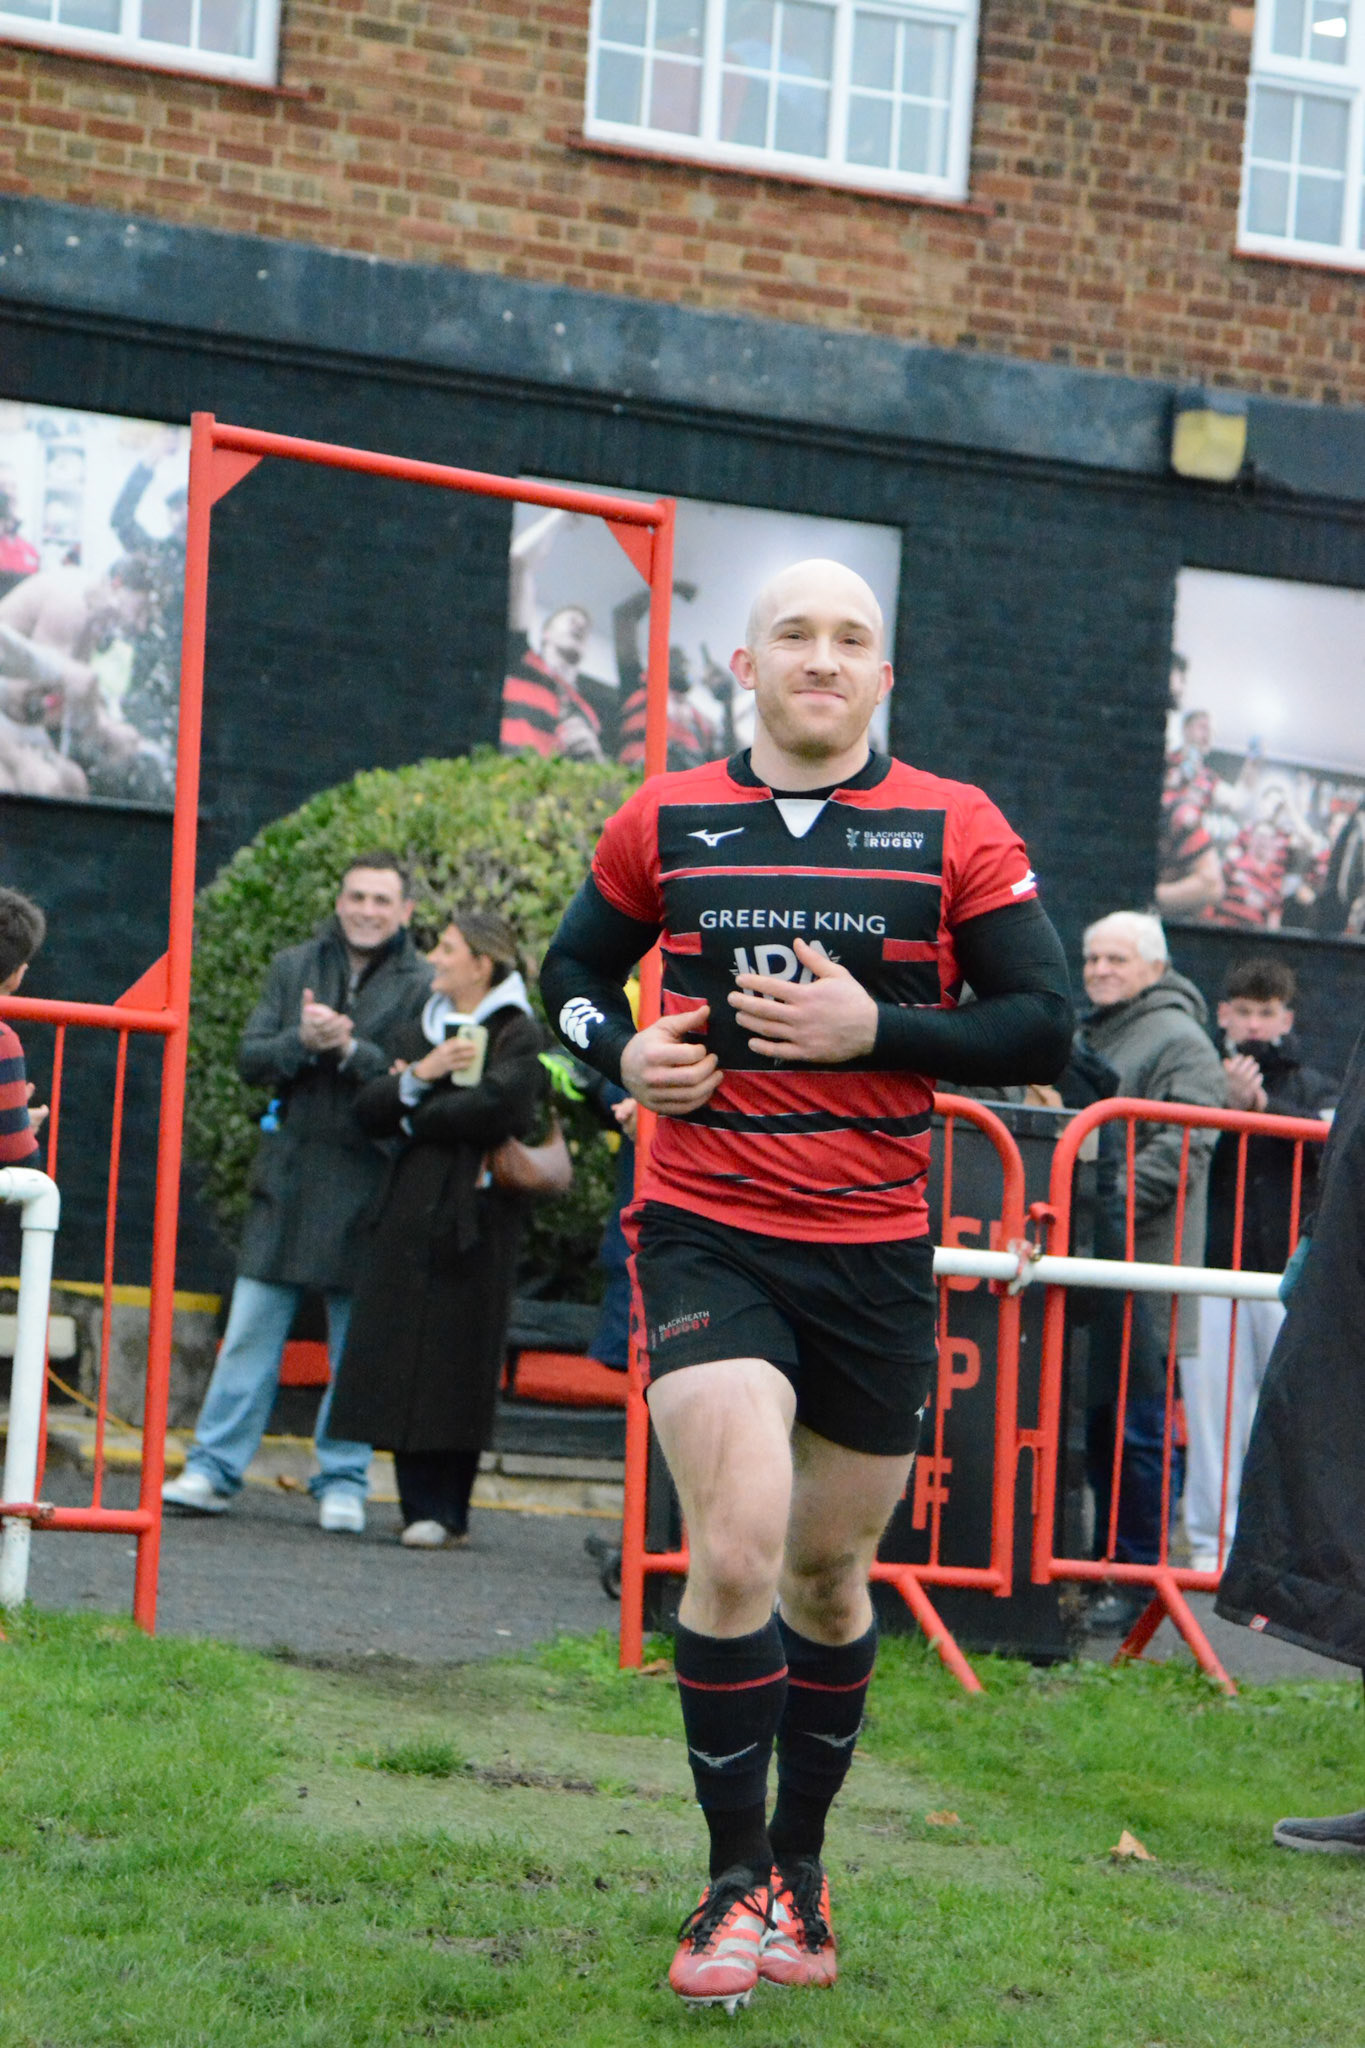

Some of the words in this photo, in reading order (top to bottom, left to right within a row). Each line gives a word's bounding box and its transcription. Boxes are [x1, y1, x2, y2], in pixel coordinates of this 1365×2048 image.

[863, 831, 924, 839] BLACKHEATH
[869, 838, 923, 849] RUGBY
[699, 909, 807, 930] GREENE
[814, 911, 886, 935] KING
[658, 1311, 710, 1333] BLACKHEATH
[663, 1317, 710, 1339] RUGBY
